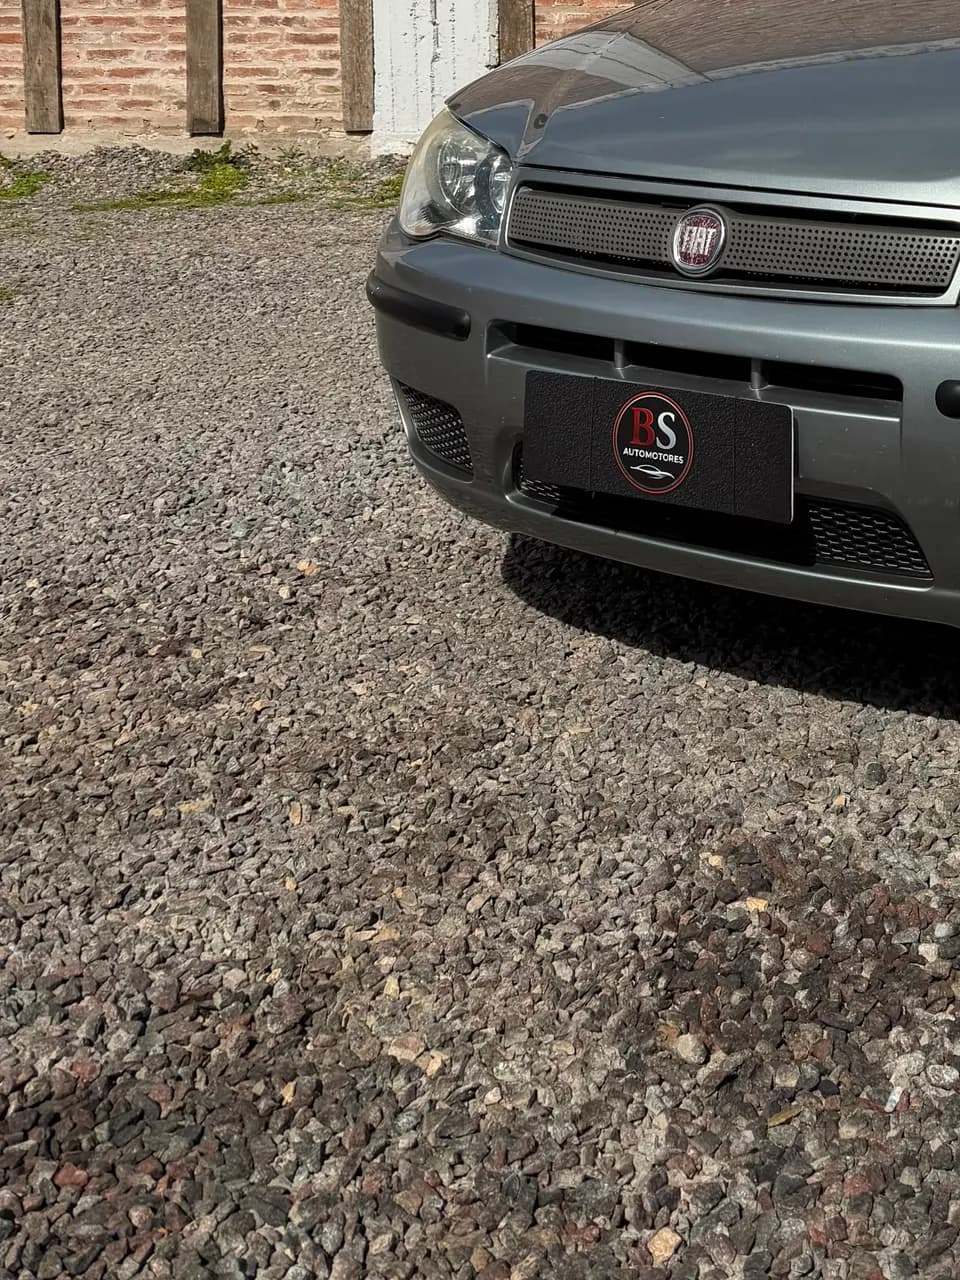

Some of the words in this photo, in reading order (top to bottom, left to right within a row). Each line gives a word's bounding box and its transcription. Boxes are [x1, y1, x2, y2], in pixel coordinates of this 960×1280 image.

[681, 226, 717, 256] FIAT
[630, 406, 677, 450] BS
[623, 447, 684, 465] AUTOMOTORES
